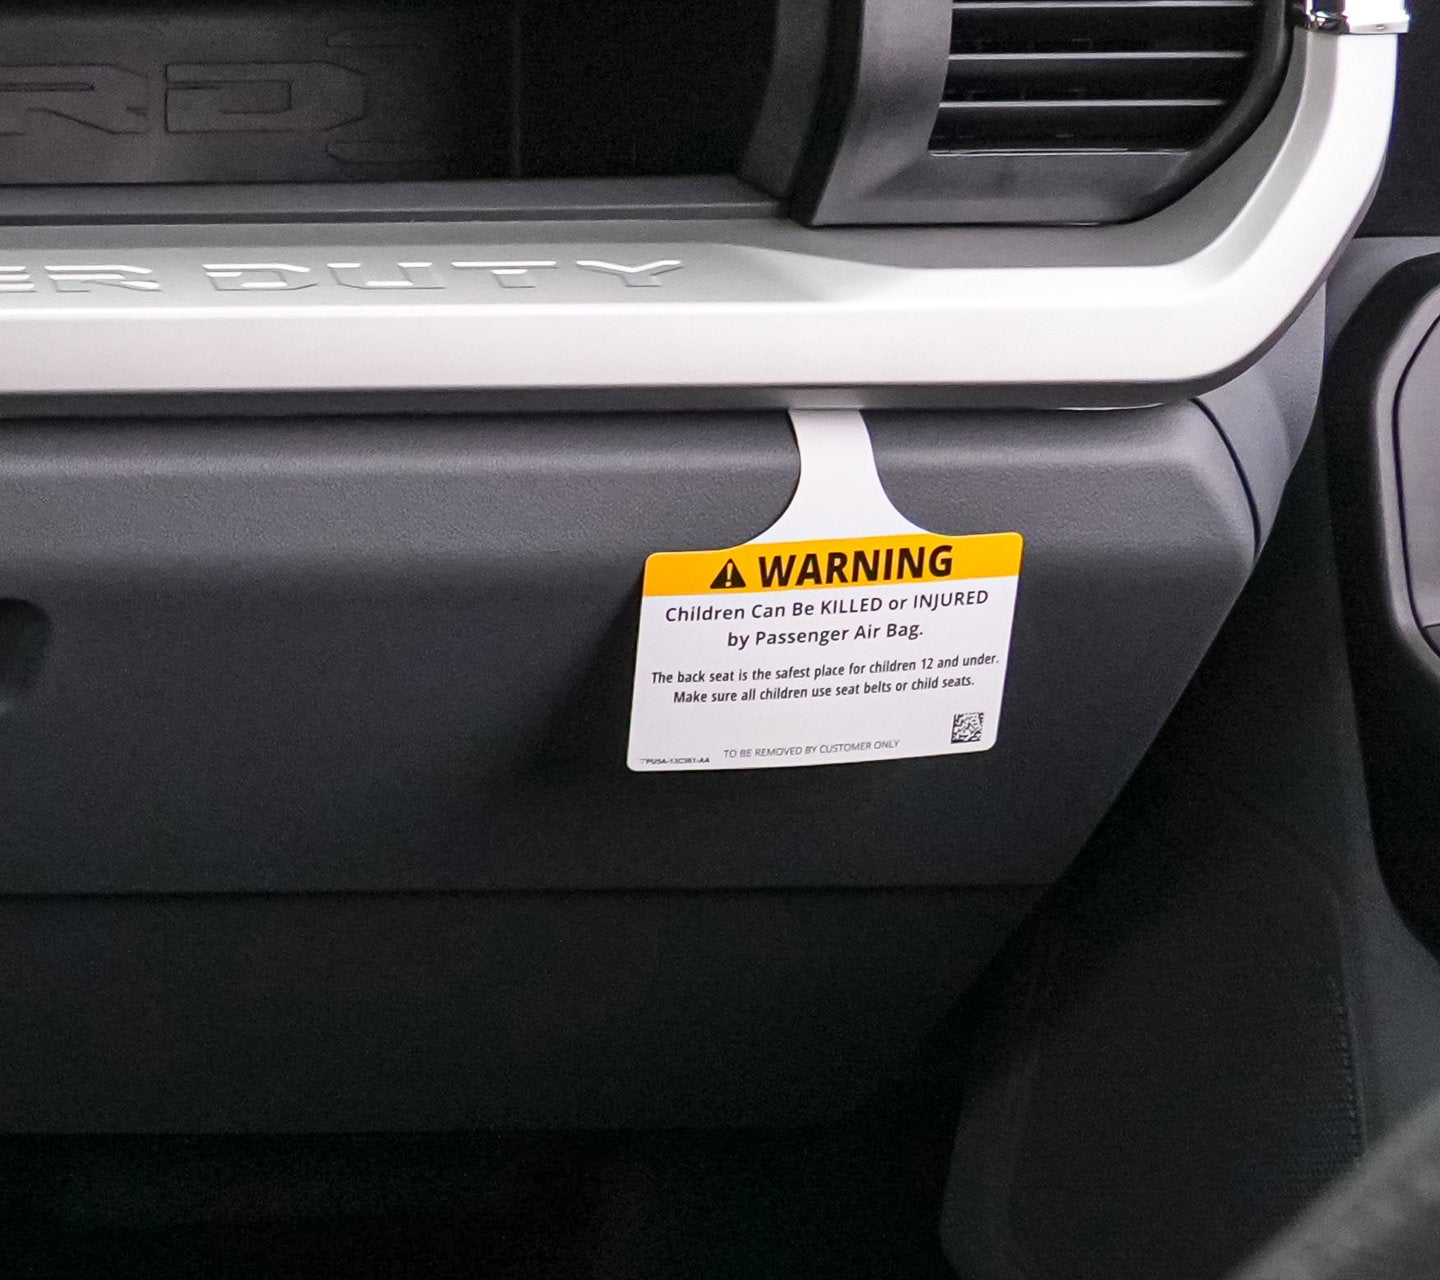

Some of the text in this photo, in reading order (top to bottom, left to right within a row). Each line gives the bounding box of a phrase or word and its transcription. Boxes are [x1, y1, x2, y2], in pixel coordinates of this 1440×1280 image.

[202, 258, 683, 293] DUTY
[757, 545, 954, 588] WARNING
[665, 589, 989, 622] Children Can Be KILLED or INJURED
[727, 622, 924, 650] by Passenger Air Bag.
[651, 653, 1000, 684] The back seat is the safest place for children 12 and under.
[673, 675, 975, 703] Make sure all children use seat belts or child seats.
[723, 739, 900, 758] TO BE REMOVED BY CUSTOMER ONLY
